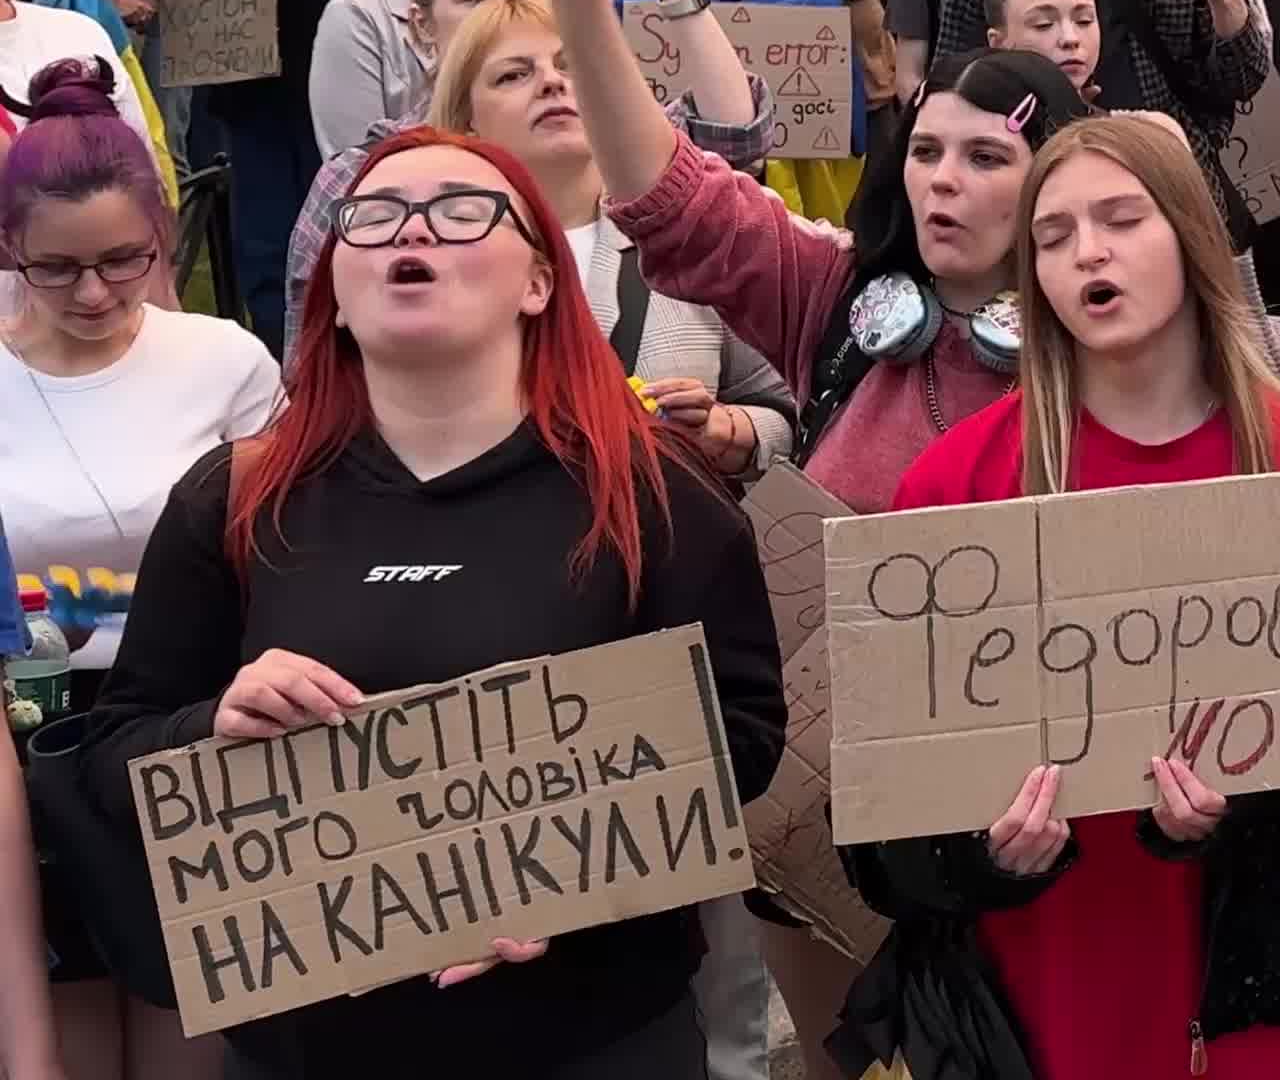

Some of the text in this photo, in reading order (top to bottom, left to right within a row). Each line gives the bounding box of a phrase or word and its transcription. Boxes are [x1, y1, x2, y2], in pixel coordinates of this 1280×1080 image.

[766, 42, 849, 66] error:
[364, 563, 463, 585] STAFF
[1144, 697, 1275, 783] МО
[168, 809, 358, 904] МОГО
[190, 643, 747, 1004] НА КАНІКУЛИ!
